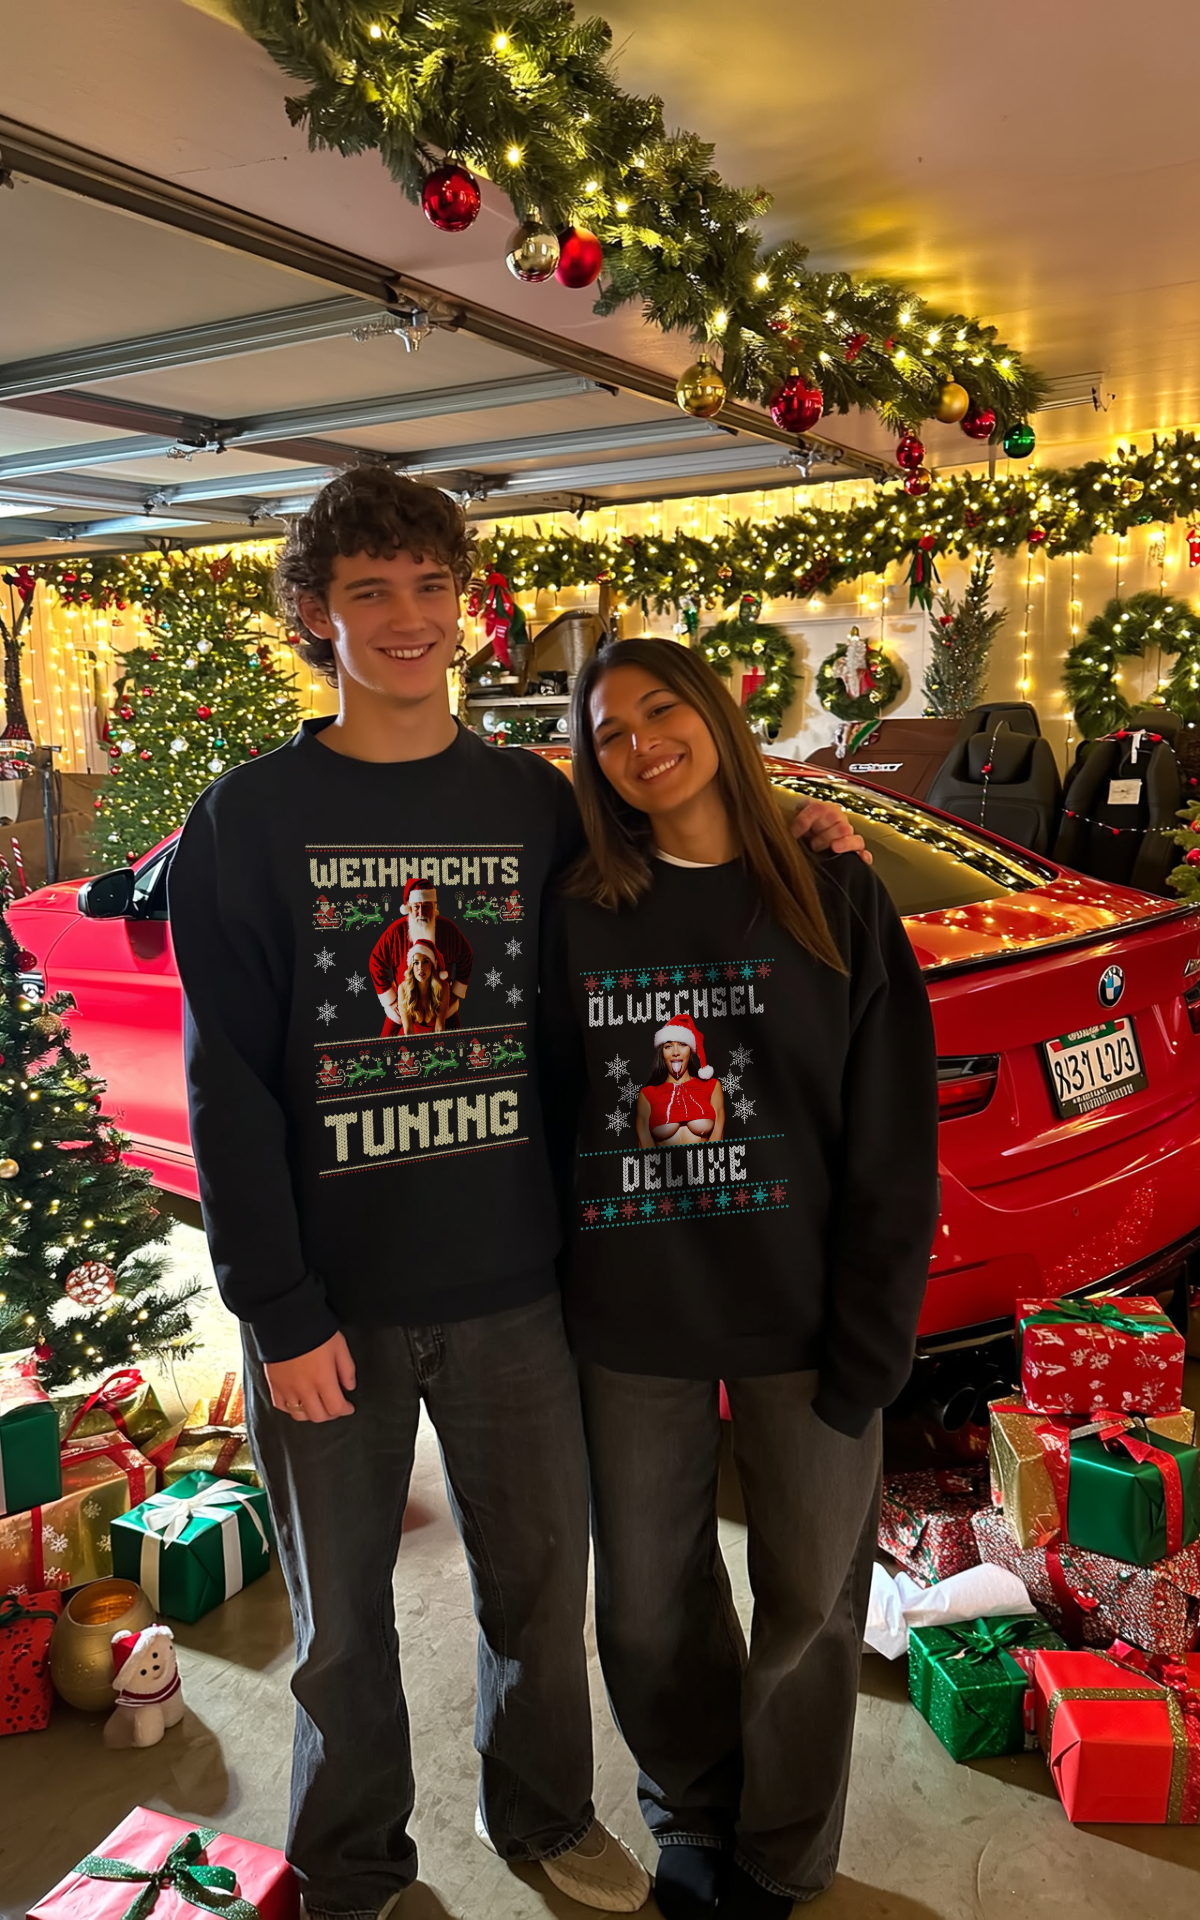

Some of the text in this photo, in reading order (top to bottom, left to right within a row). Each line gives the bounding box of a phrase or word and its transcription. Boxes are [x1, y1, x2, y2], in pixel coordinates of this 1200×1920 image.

[309, 857, 519, 888] WEIHNACHTS
[588, 985, 764, 1028] ÖLWECHSEL
[324, 1090, 518, 1162] TUNING
[622, 1144, 747, 1193] DELUXE
